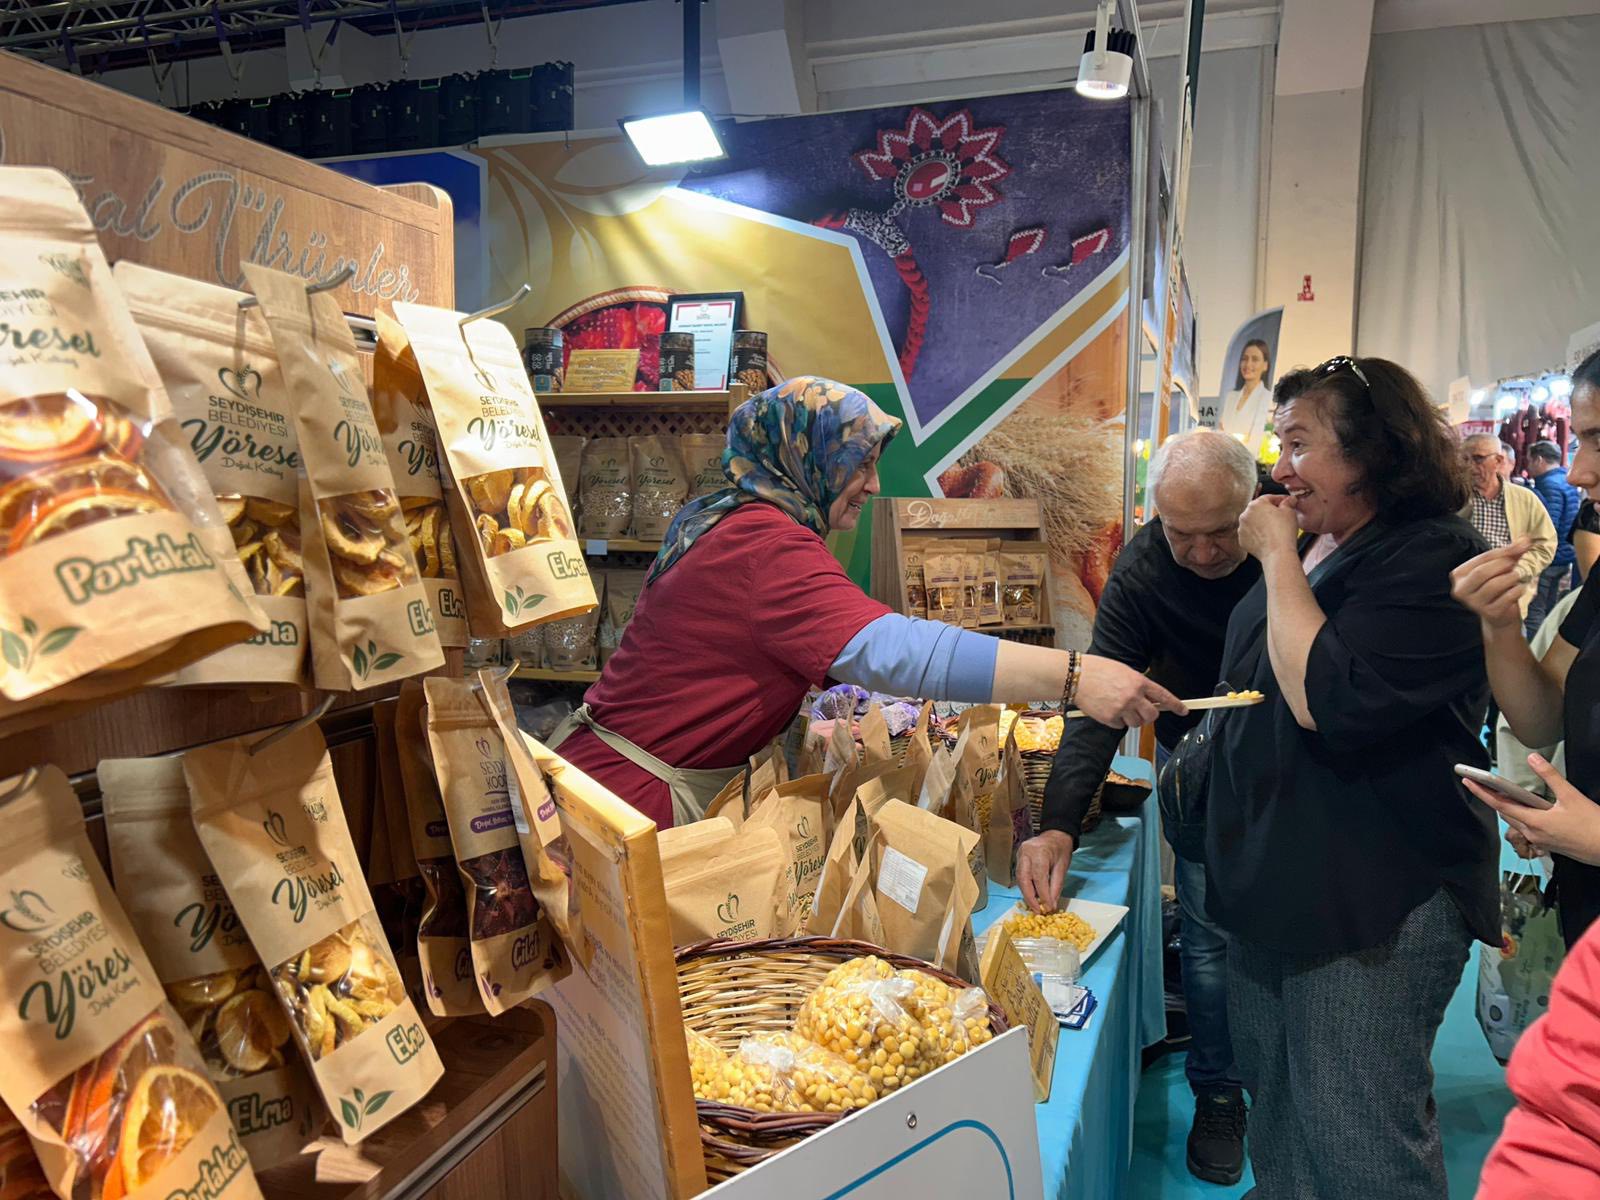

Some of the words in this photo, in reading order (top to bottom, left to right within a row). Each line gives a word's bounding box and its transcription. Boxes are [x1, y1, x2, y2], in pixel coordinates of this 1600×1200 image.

[170, 171, 420, 304] Ürünler
[0, 323, 101, 358] resel
[208, 395, 286, 425] SEYDİŞEHİR
[208, 409, 289, 438] BELEDİYESİ
[181, 418, 299, 468] Yörese
[55, 532, 215, 606] Portakal
[271, 861, 344, 923] Yöresel
[39, 924, 110, 975] BELEDİYES
